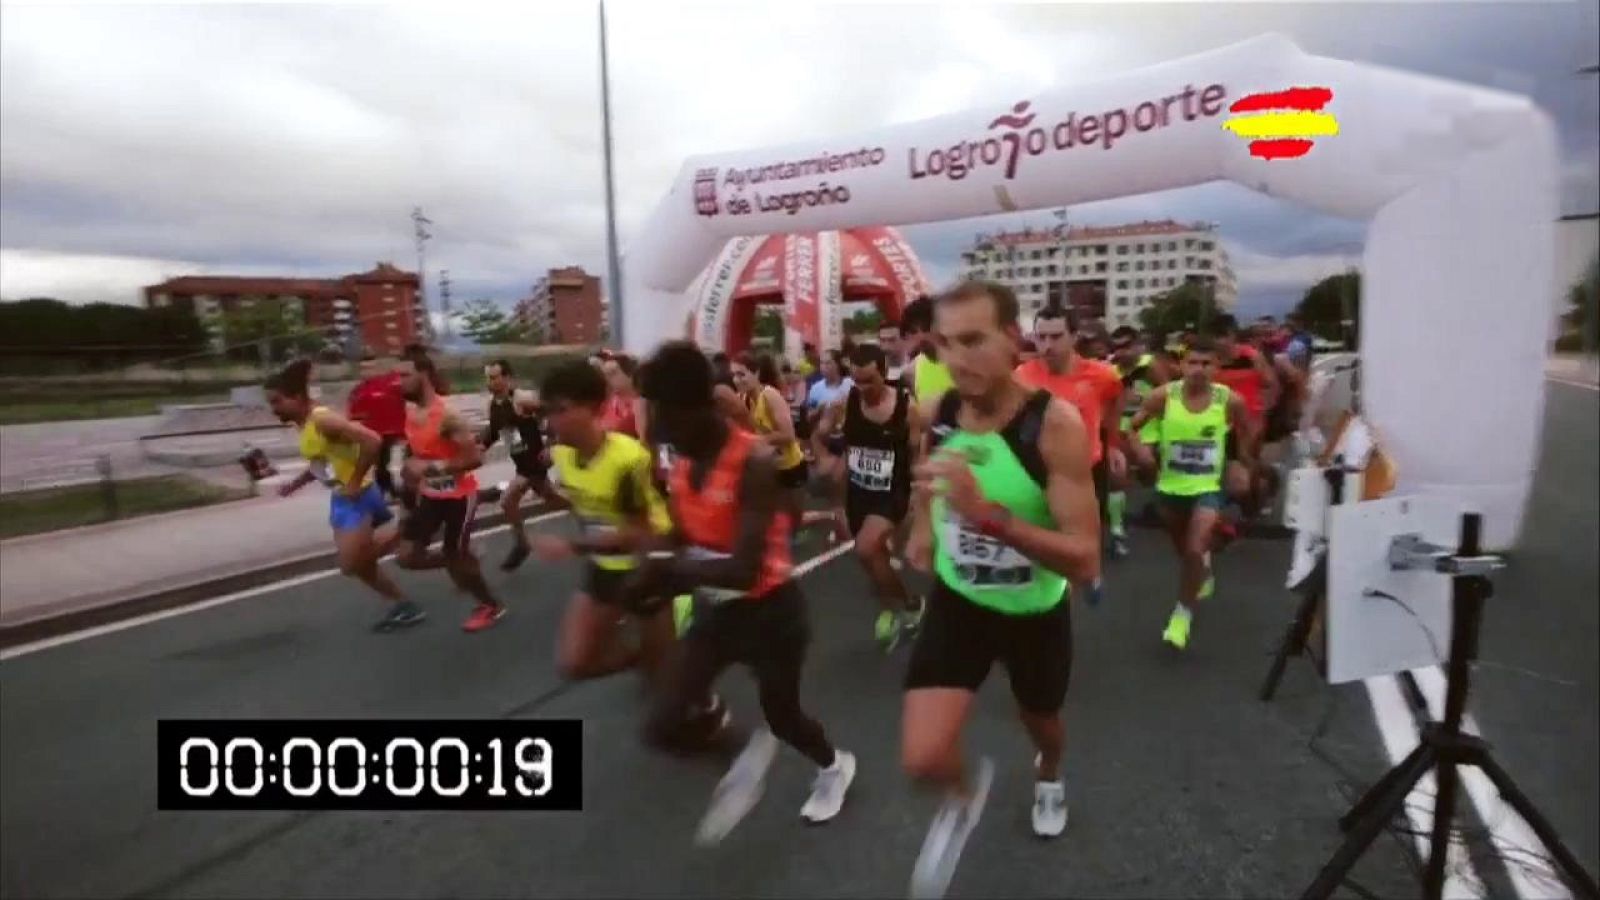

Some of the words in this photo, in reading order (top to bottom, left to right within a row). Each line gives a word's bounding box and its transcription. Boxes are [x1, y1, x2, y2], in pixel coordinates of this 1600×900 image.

[1052, 83, 1227, 151] deporte
[724, 147, 885, 192] Ayuntamiento
[726, 194, 751, 215] de
[756, 182, 851, 215] Logroño
